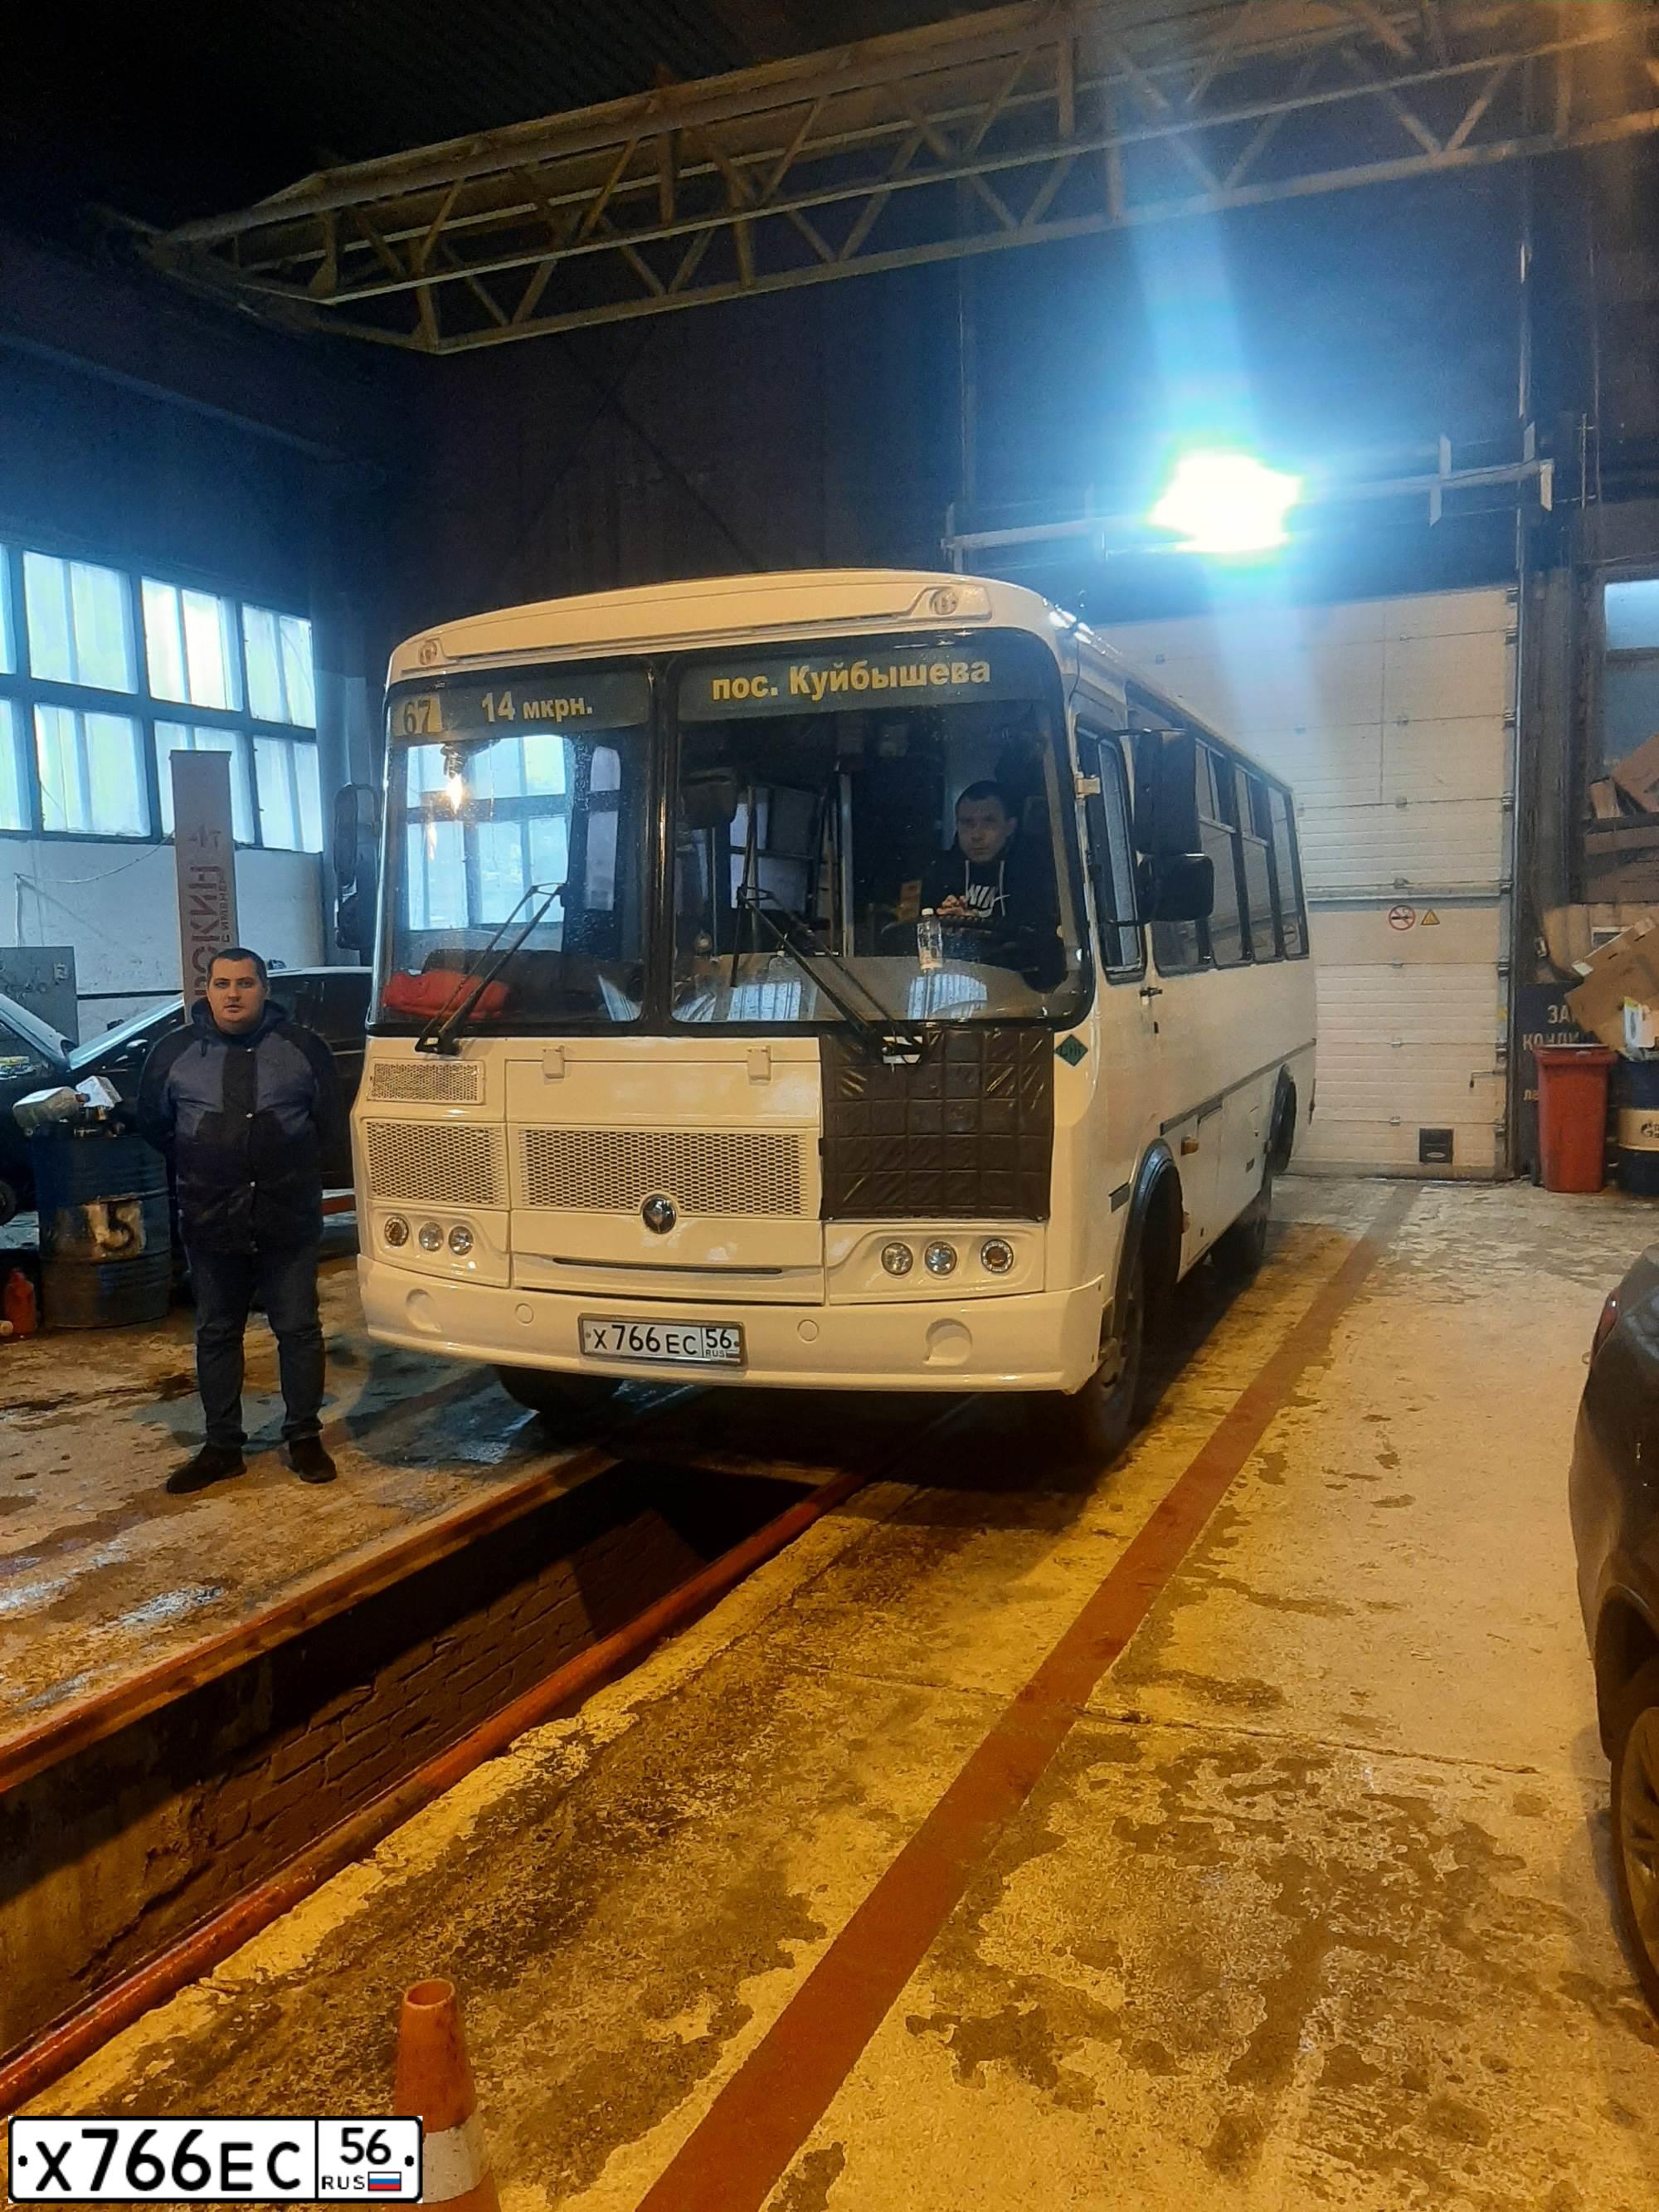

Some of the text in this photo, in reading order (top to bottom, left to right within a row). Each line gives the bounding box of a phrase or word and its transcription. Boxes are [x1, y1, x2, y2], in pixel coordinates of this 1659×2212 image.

[712, 660, 991, 701] пос. Куйбышева
[403, 699, 432, 735] 67
[482, 691, 593, 723] 14 мкрн.
[1547, 1005, 1571, 1024] ЗА
[1523, 1032, 1580, 1050] КОНДИ
[593, 1324, 698, 1356] Х766ЕС
[705, 1328, 732, 1349] 56
[705, 1349, 725, 1358] RUS
